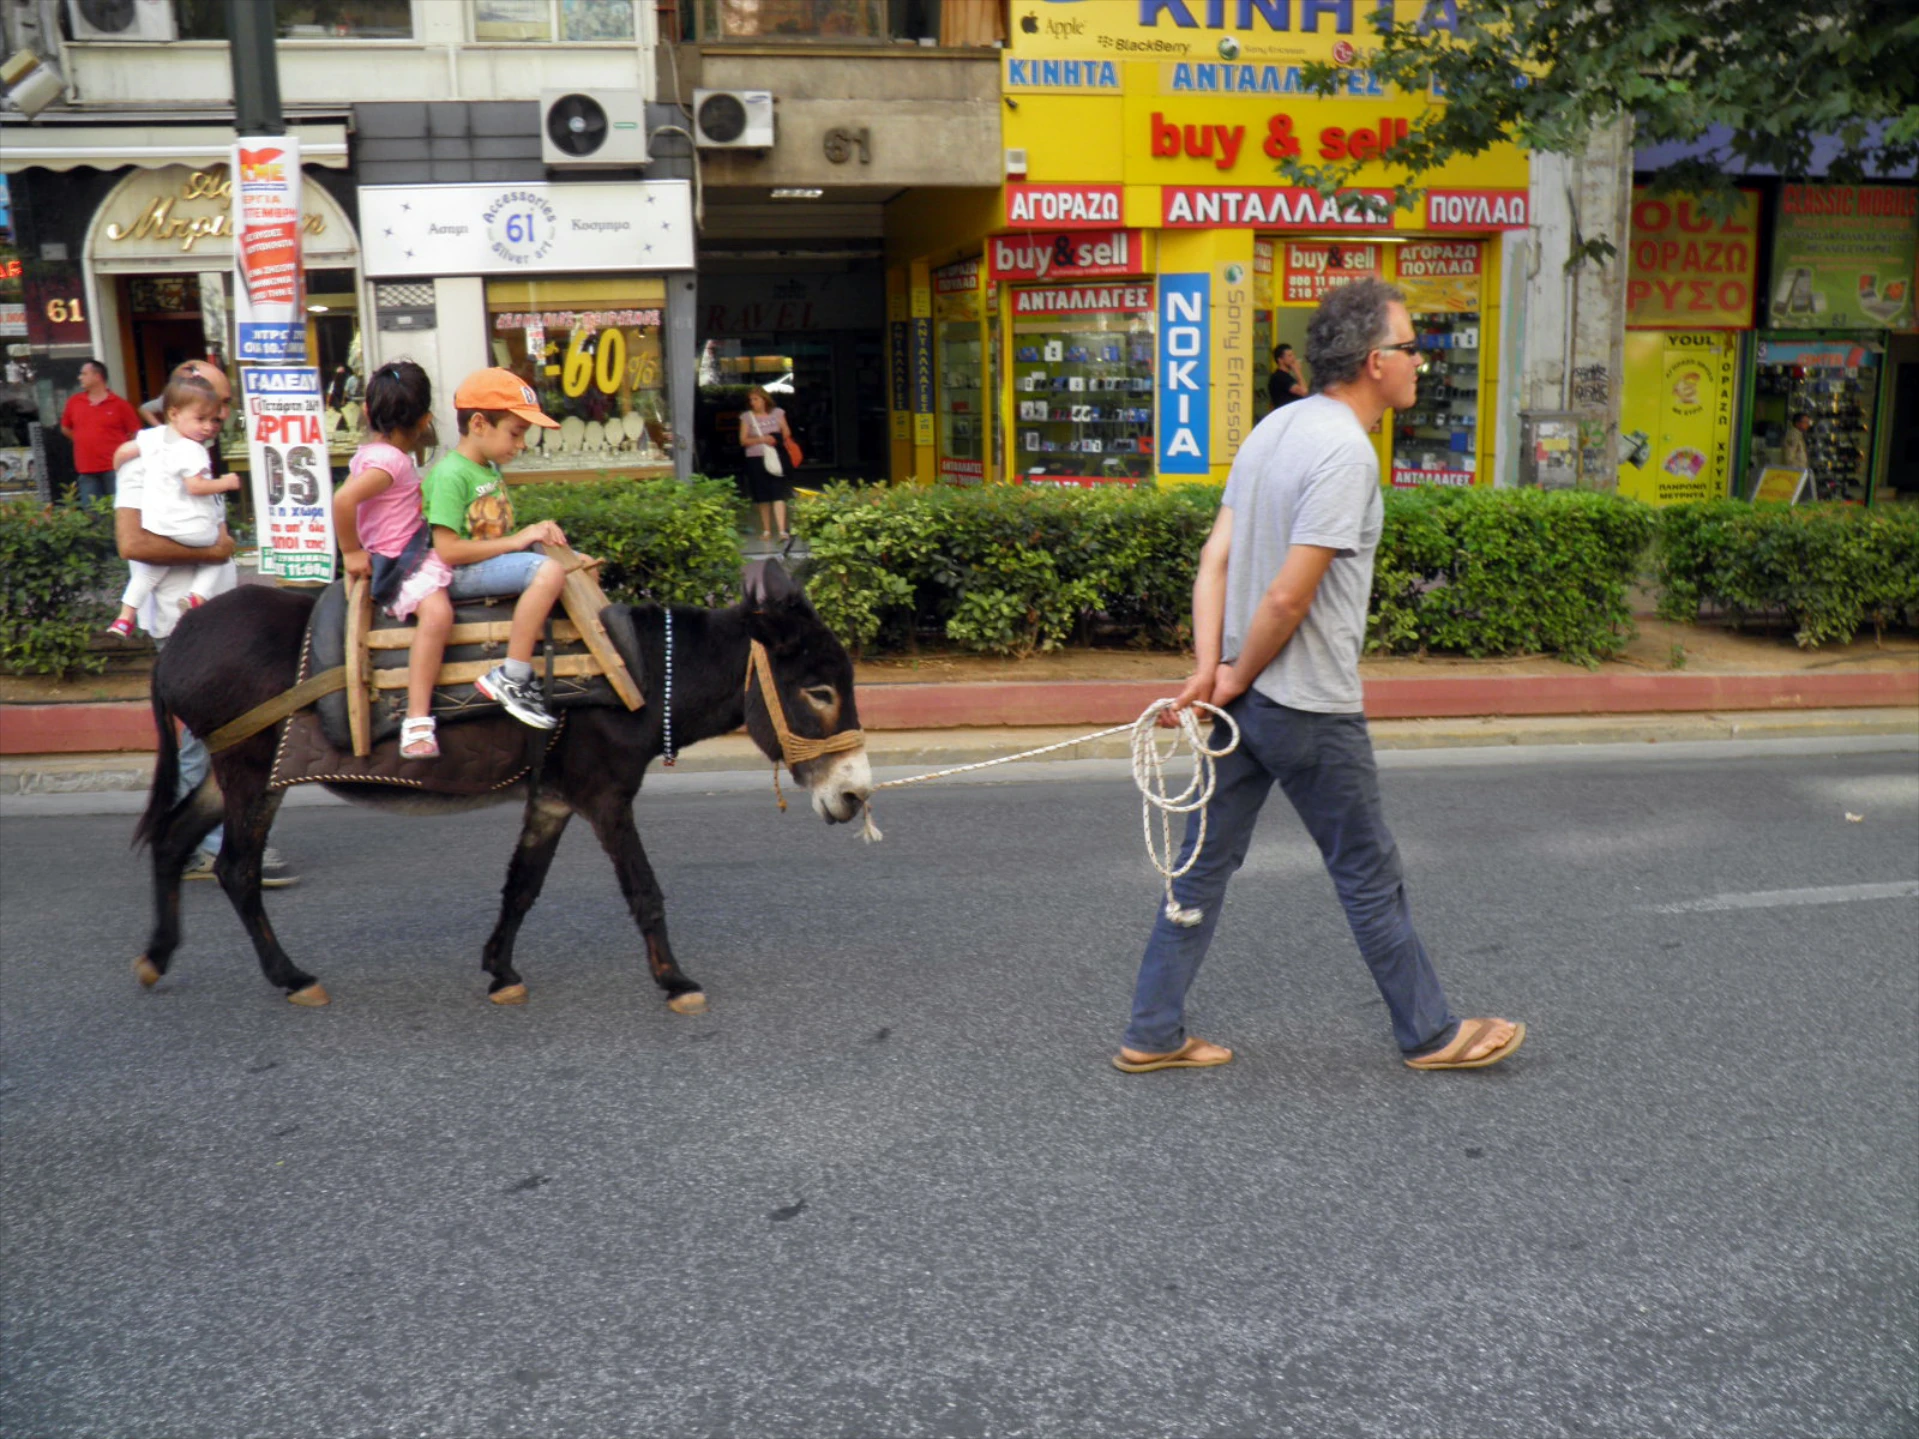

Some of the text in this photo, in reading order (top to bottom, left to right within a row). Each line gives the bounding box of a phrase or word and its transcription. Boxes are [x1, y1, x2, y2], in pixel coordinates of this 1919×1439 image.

[1045, 17, 1084, 39] Apple
[1115, 38, 1190, 56] BlackBerry
[1009, 59, 1118, 87] ΚΙΝΗΤΑ
[1172, 63, 1383, 96] ΑΝΤΑΛΛΓΕΣ
[822, 126, 872, 165] 61
[1150, 112, 1408, 169] buy & sell
[1011, 193, 1119, 222] ΑΓΟΡΑΖΩ
[1431, 197, 1525, 225] ΠΟΥΛΑΩ
[506, 213, 534, 243] 61
[1400, 245, 1477, 260] ΑΓΟΡΑΖΩ
[1630, 240, 1749, 273] ΟΡΑΖΩ
[1402, 260, 1474, 276] ΠΟΥΛΑΩ
[47, 298, 84, 323] 61
[1017, 288, 1149, 312] ΑΝΤΑΛΛΑΓΕΣ
[1224, 289, 1245, 350] Sony
[1166, 292, 1202, 458] NOKIA
[1717, 341, 1732, 426] ΓΟΡΑΖΩ
